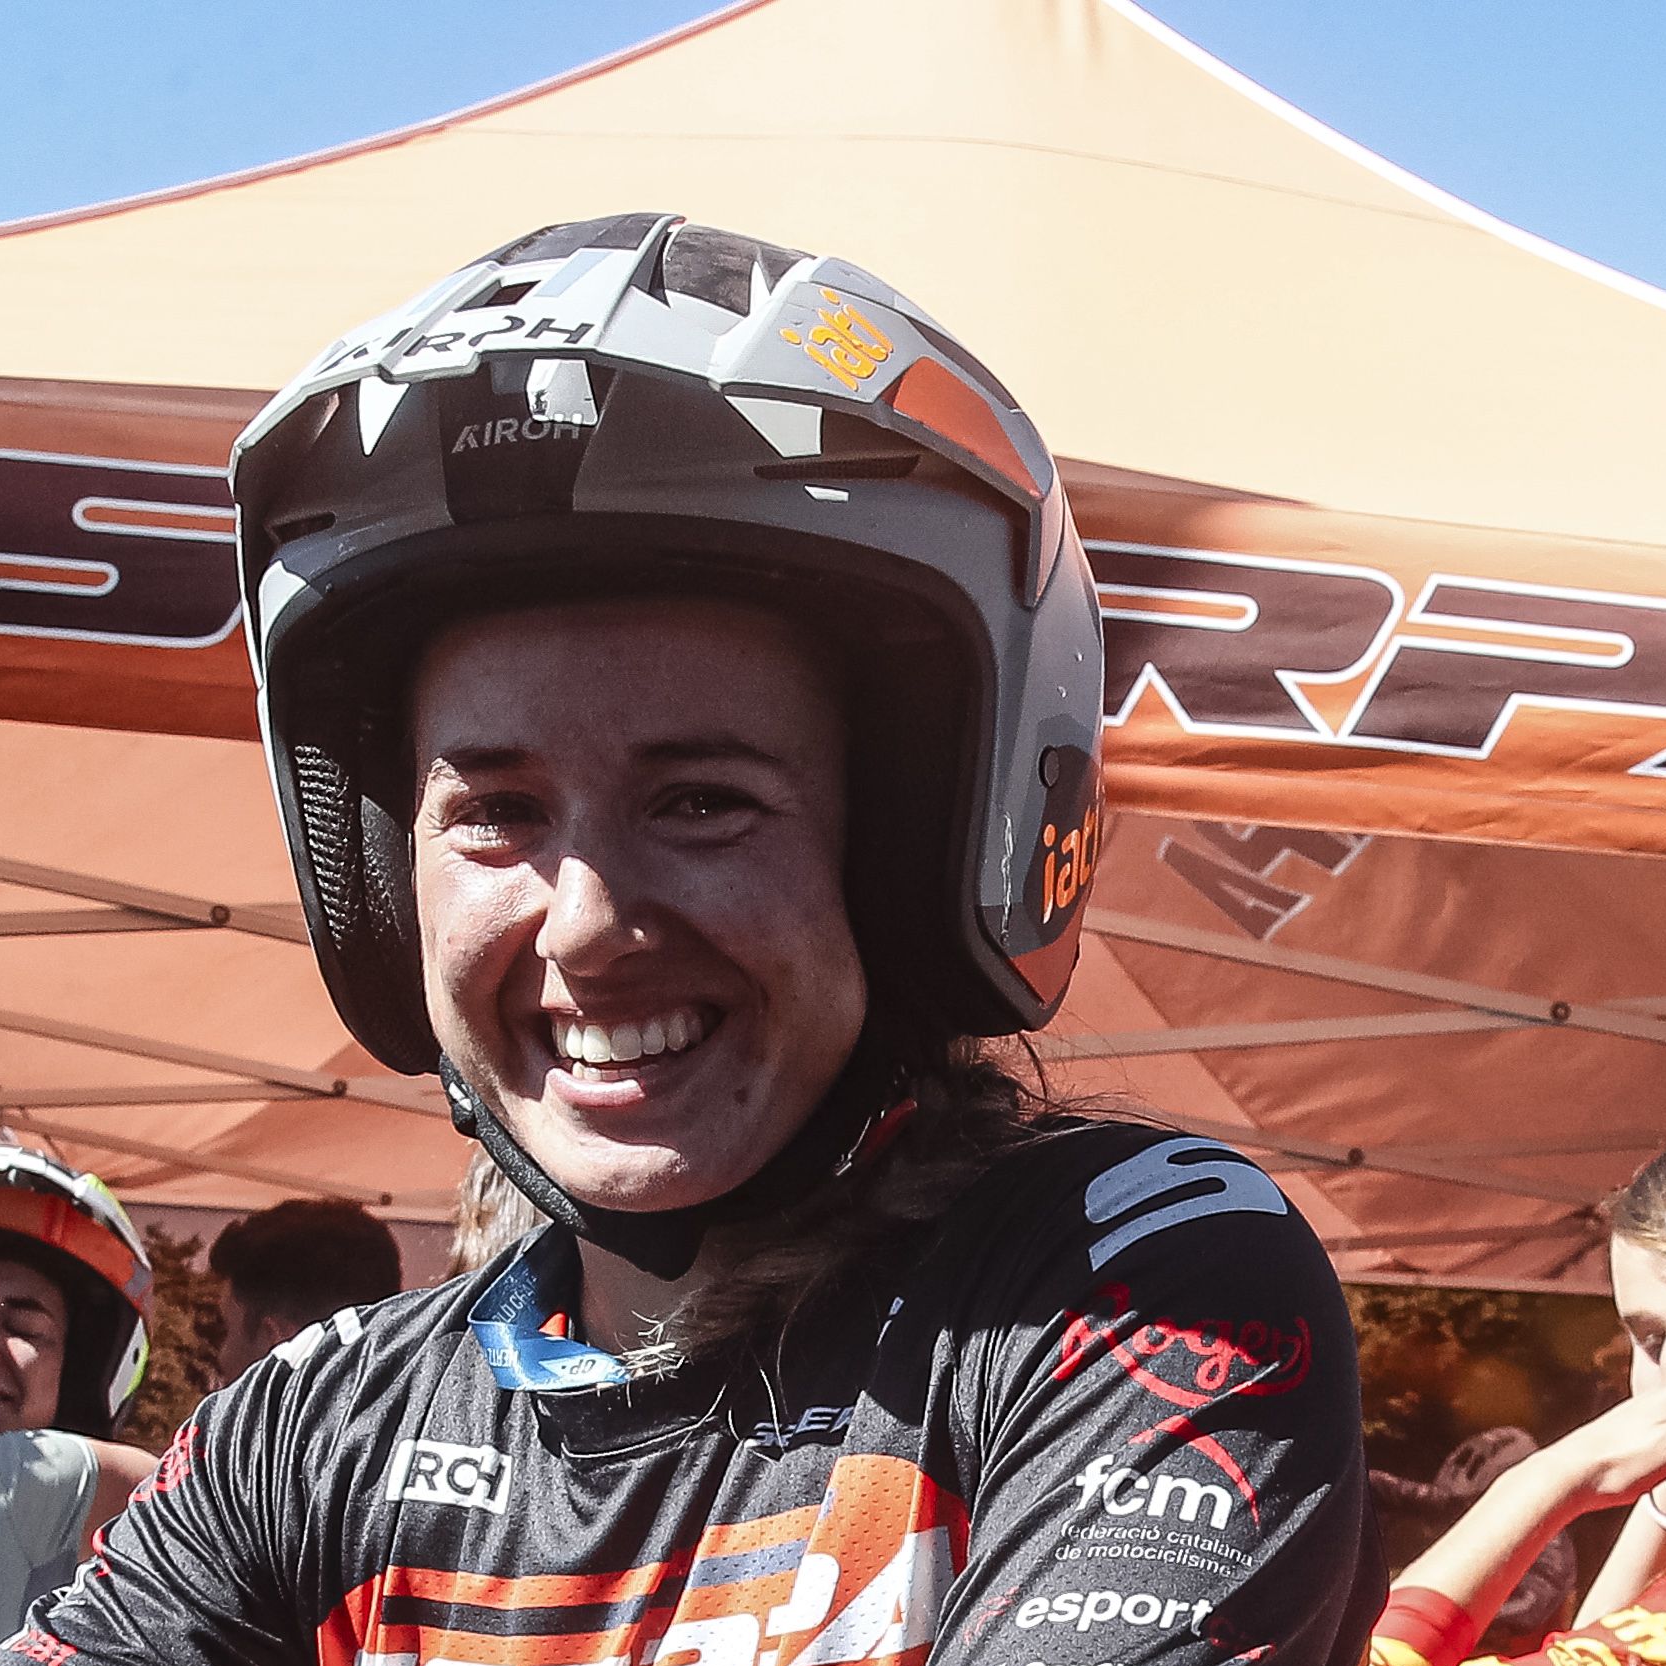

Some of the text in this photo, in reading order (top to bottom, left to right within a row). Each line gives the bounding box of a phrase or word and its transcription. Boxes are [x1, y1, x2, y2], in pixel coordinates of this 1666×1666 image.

[779, 287, 895, 392] iati
[450, 413, 586, 454] AIROH
[1042, 806, 1099, 925] iat
[1074, 1454, 1233, 1530] fcm
[1054, 1544, 1080, 1561] de
[1061, 1519, 1254, 1568] federació catalana
